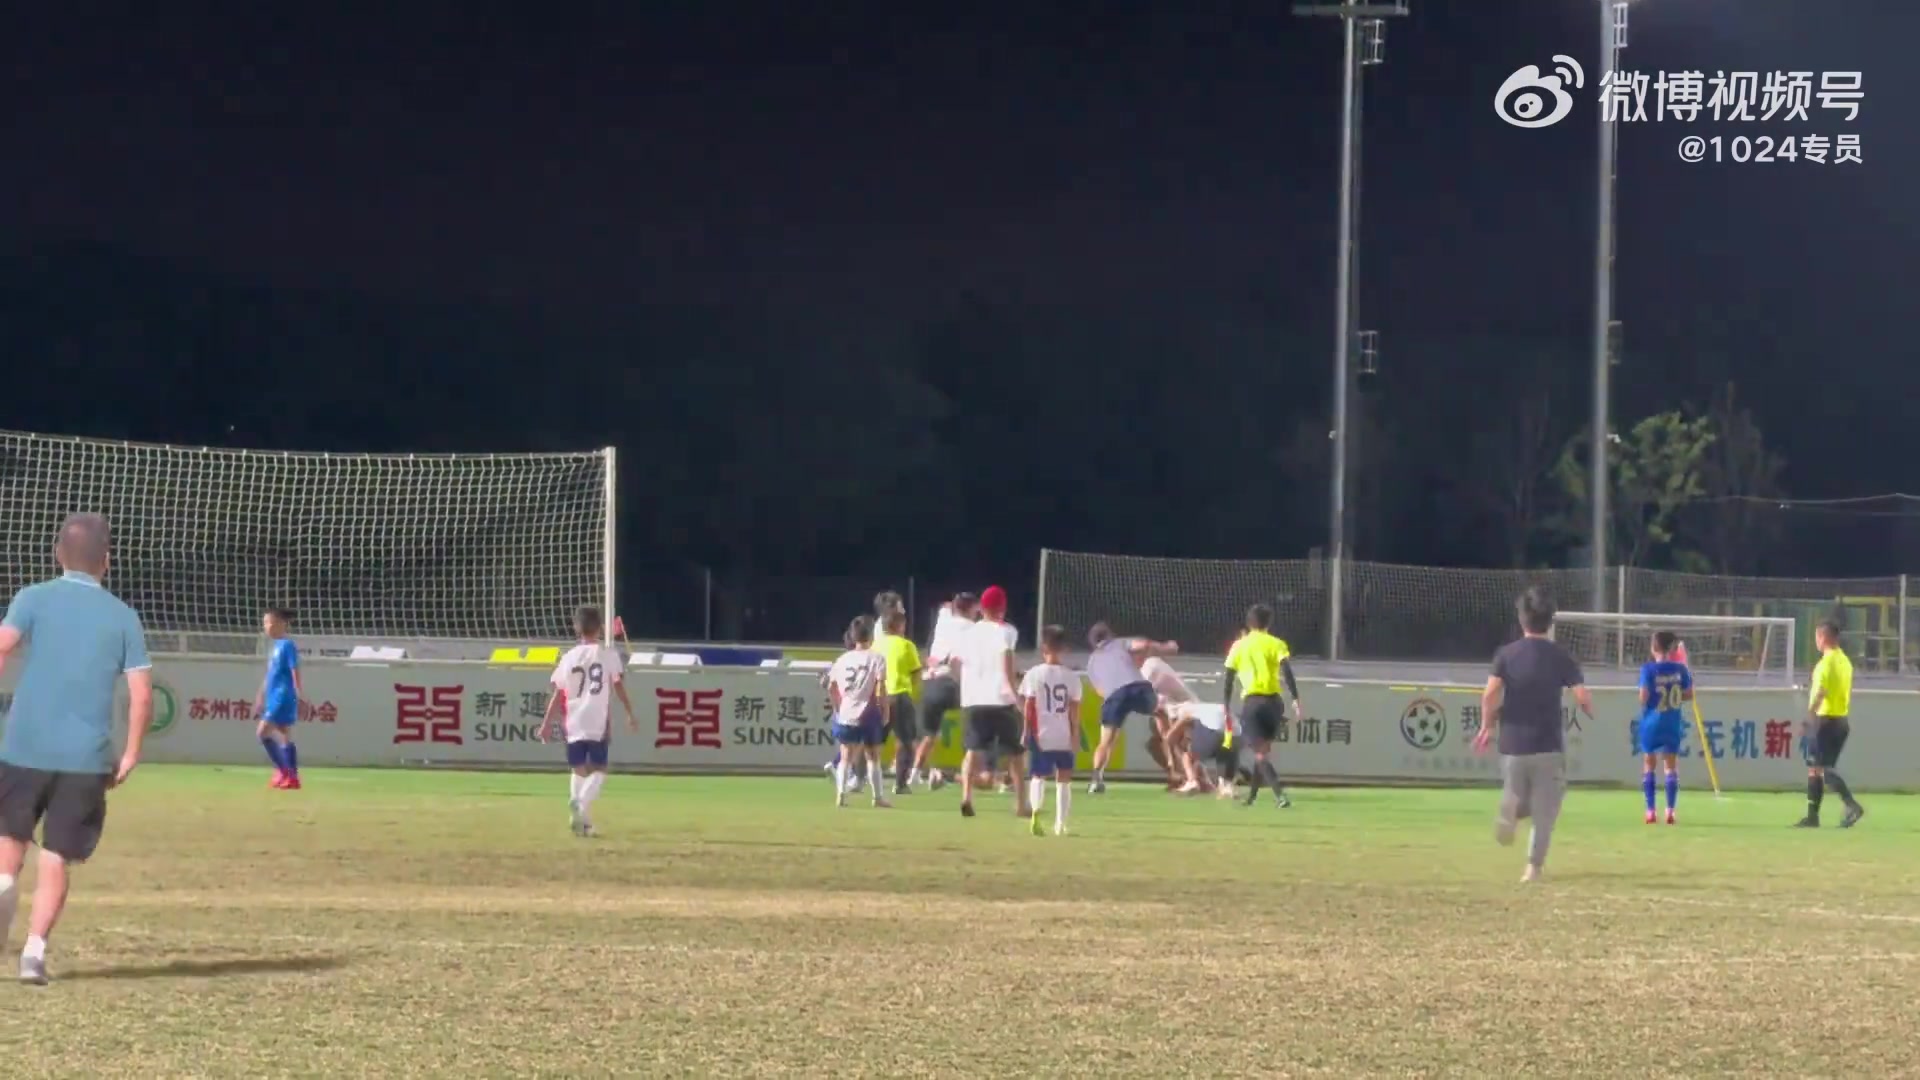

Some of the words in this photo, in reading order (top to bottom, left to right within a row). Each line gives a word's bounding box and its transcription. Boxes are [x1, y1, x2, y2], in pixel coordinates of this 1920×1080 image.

[571, 663, 603, 698] 79
[189, 698, 337, 722] 苏州市协会
[1044, 682, 1068, 713] 19
